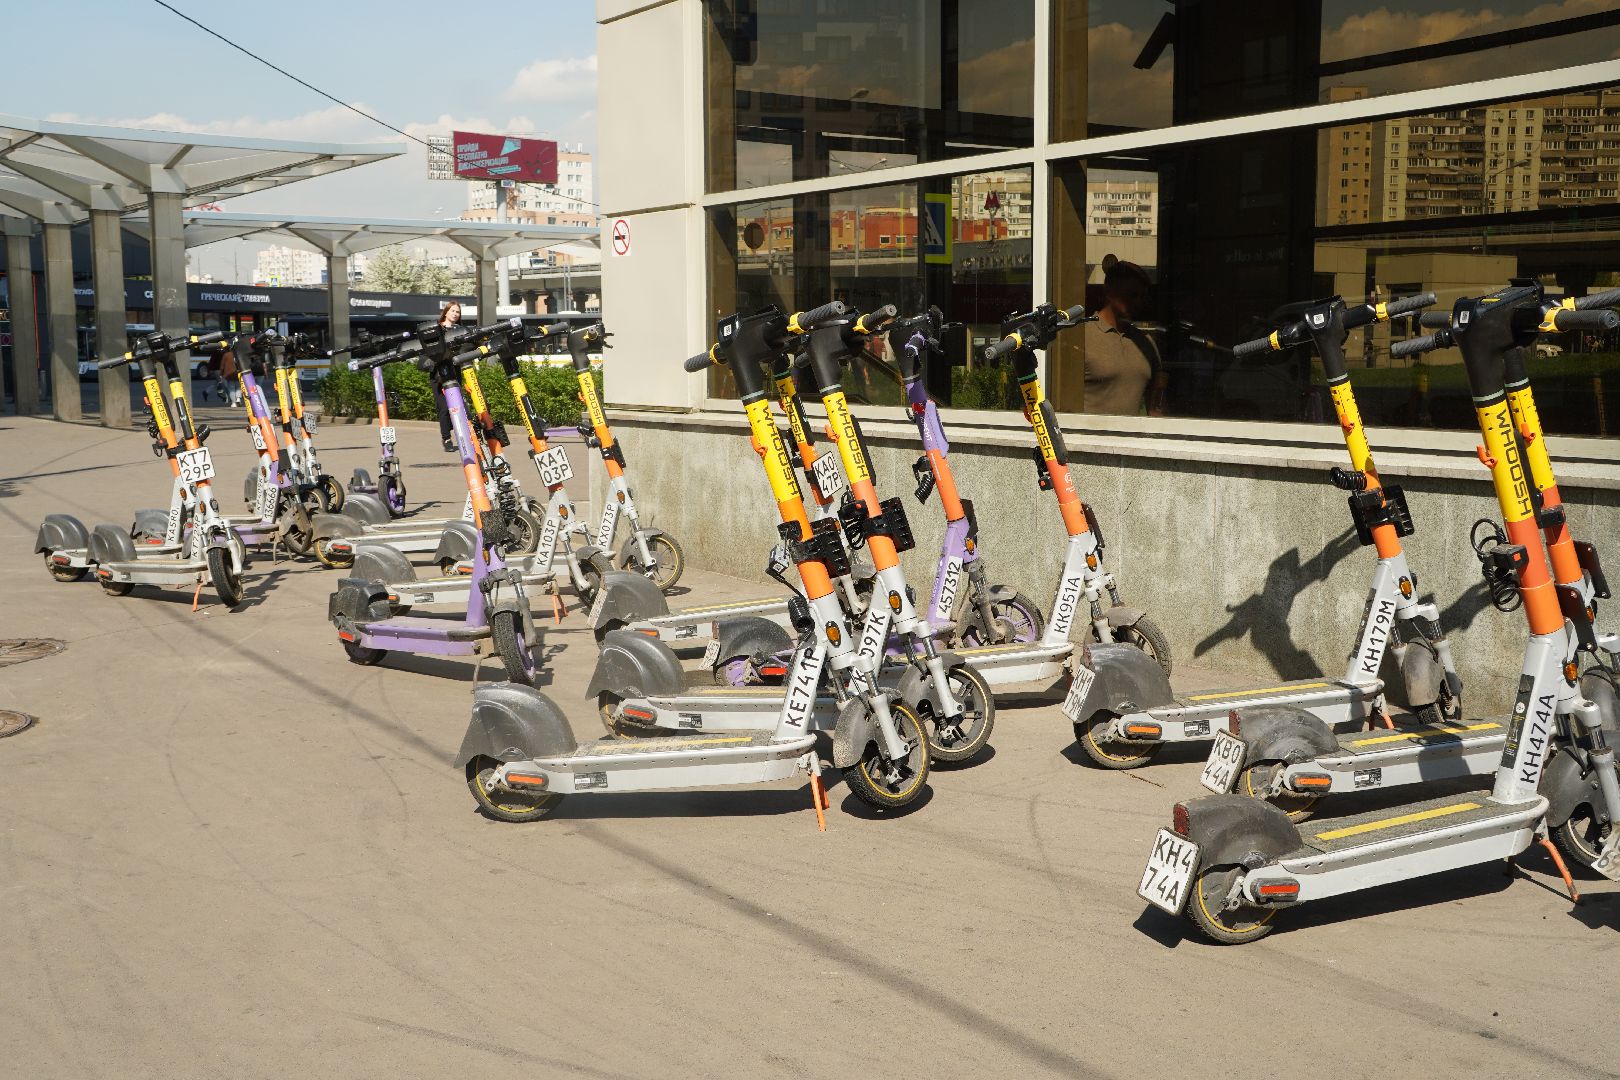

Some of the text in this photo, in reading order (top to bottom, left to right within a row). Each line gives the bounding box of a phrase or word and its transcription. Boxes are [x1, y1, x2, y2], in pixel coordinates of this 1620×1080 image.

[150, 382, 169, 427] WHOOSH
[583, 376, 603, 425] WHOOSH
[778, 384, 804, 443] WHOOSH
[1026, 387, 1054, 459] WHOOSH
[179, 450, 207, 467] KT7
[537, 449, 567, 470] KA1
[762, 406, 799, 495] WHOOSH
[836, 397, 869, 479] WHOOSH
[183, 464, 211, 481] 29P
[543, 464, 570, 483] 03P
[815, 455, 836, 479] KA0
[822, 473, 840, 494] 47P
[1496, 409, 1532, 516] WHOOSH
[537, 518, 558, 567] KA103P
[599, 503, 615, 549] KX073P
[937, 561, 961, 613] 457312
[1054, 577, 1081, 634] KK951A
[1362, 600, 1395, 673] KH179M
[785, 647, 820, 728] KE741P
[1213, 736, 1241, 763] KB0
[1520, 694, 1555, 784] KH474A
[1205, 764, 1230, 790] 44A
[1153, 834, 1193, 874] KH4
[1144, 867, 1180, 906] 74A
